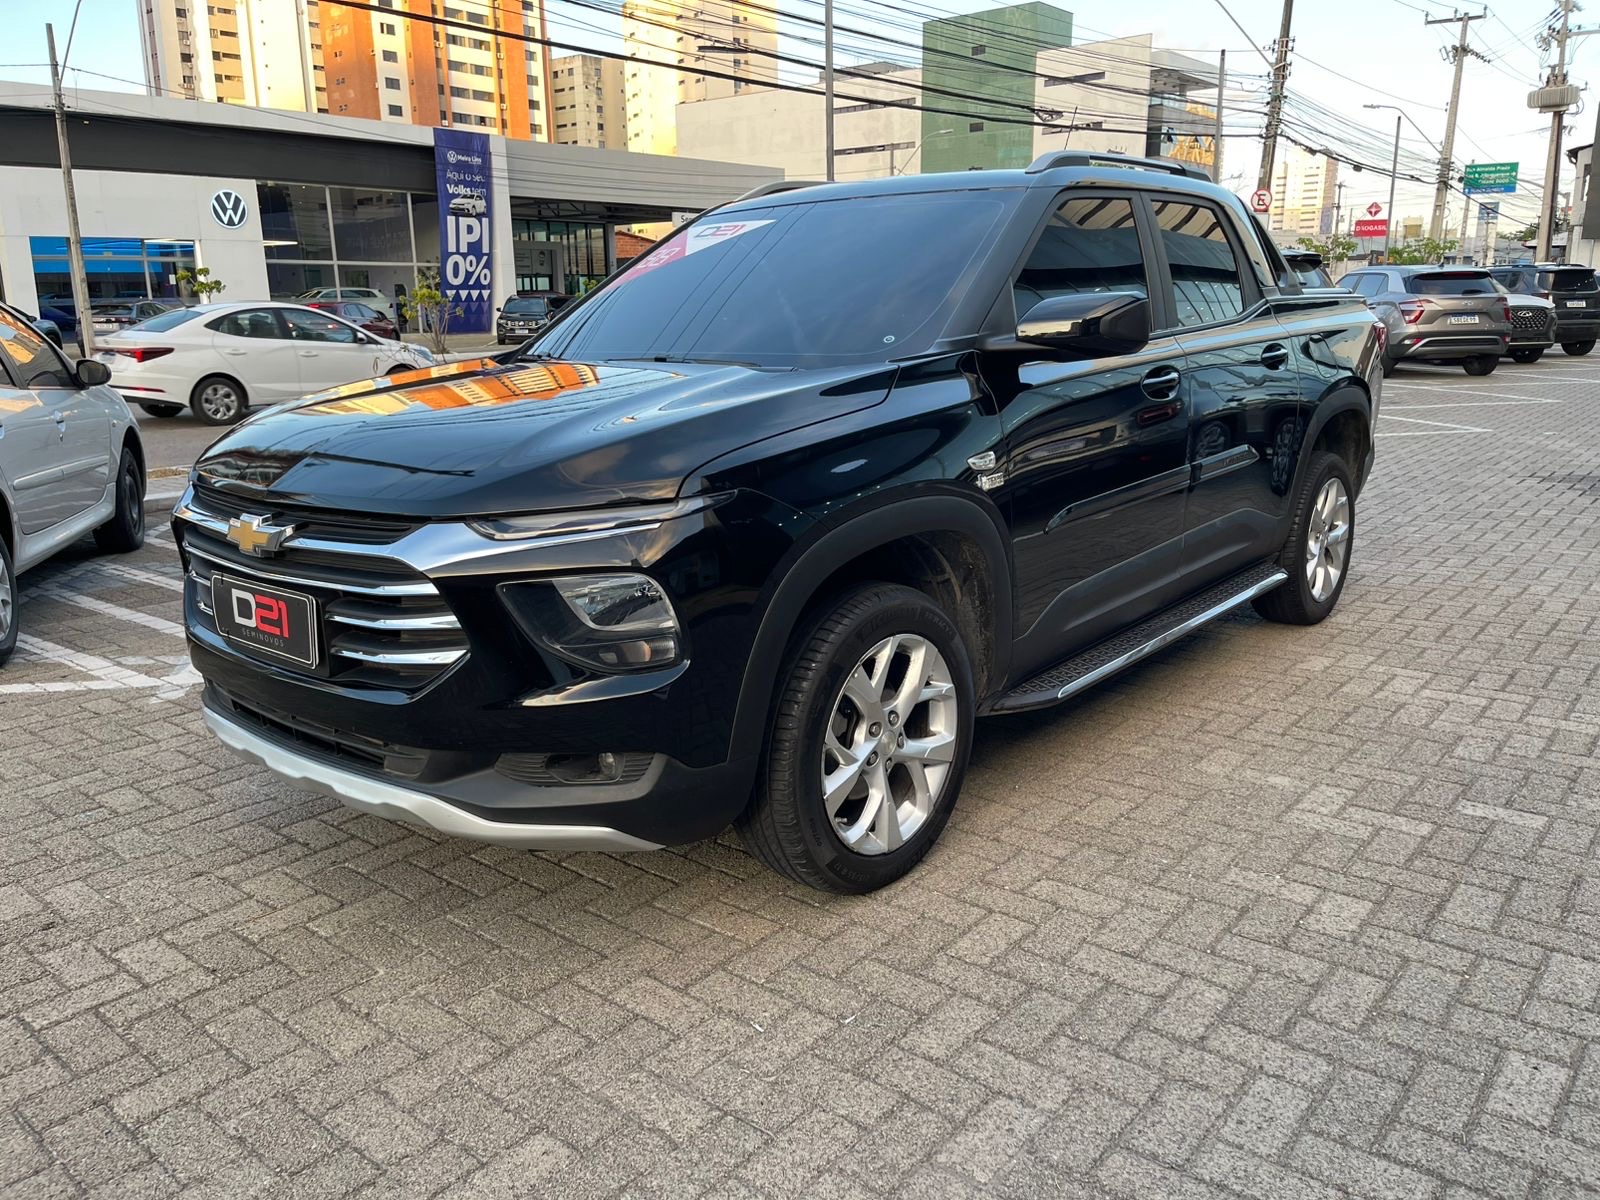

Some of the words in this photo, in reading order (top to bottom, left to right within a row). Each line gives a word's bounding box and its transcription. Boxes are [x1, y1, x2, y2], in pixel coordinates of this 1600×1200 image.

[446, 169, 464, 181] Aqui
[446, 183, 470, 195] Volks
[447, 215, 489, 253] IPI
[446, 254, 490, 285] 0%
[231, 588, 289, 638] D21
[242, 628, 284, 647] SEMINOVOS
